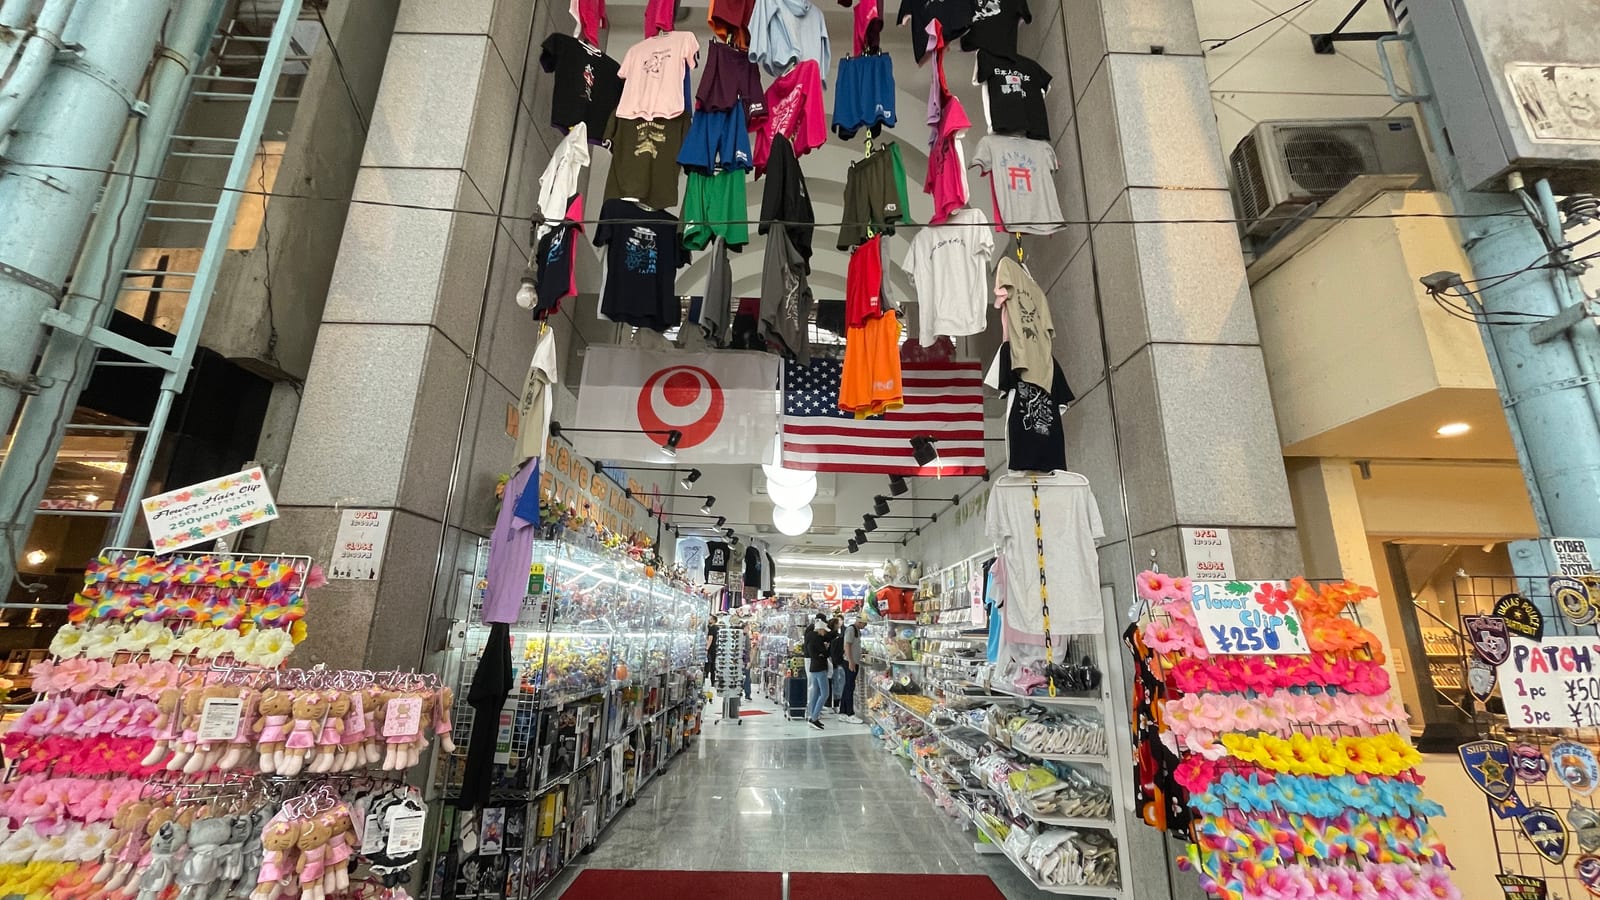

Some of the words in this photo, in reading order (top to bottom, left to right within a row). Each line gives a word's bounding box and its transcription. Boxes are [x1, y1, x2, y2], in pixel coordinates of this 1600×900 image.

[546, 433, 588, 490] Have
[153, 503, 198, 520] Flower
[202, 492, 235, 506] Hair
[239, 484, 261, 495] Clip
[169, 500, 255, 530] 250yen/each
[354, 511, 379, 520] OPEN
[1194, 529, 1217, 538] OPEN
[345, 542, 374, 551] CLOSE
[1554, 540, 1587, 553] CYBER
[1197, 561, 1225, 571] CLOSE
[1191, 584, 1250, 611] Flower
[1239, 610, 1284, 633] Clip
[1521, 601, 1540, 628] POLICE
[1210, 624, 1281, 653] ¥250
[1513, 645, 1600, 673] PATCH
[1564, 677, 1600, 702] ¥50
[1466, 743, 1505, 755] SHERIFF
[1499, 876, 1541, 888] VIETNAM
